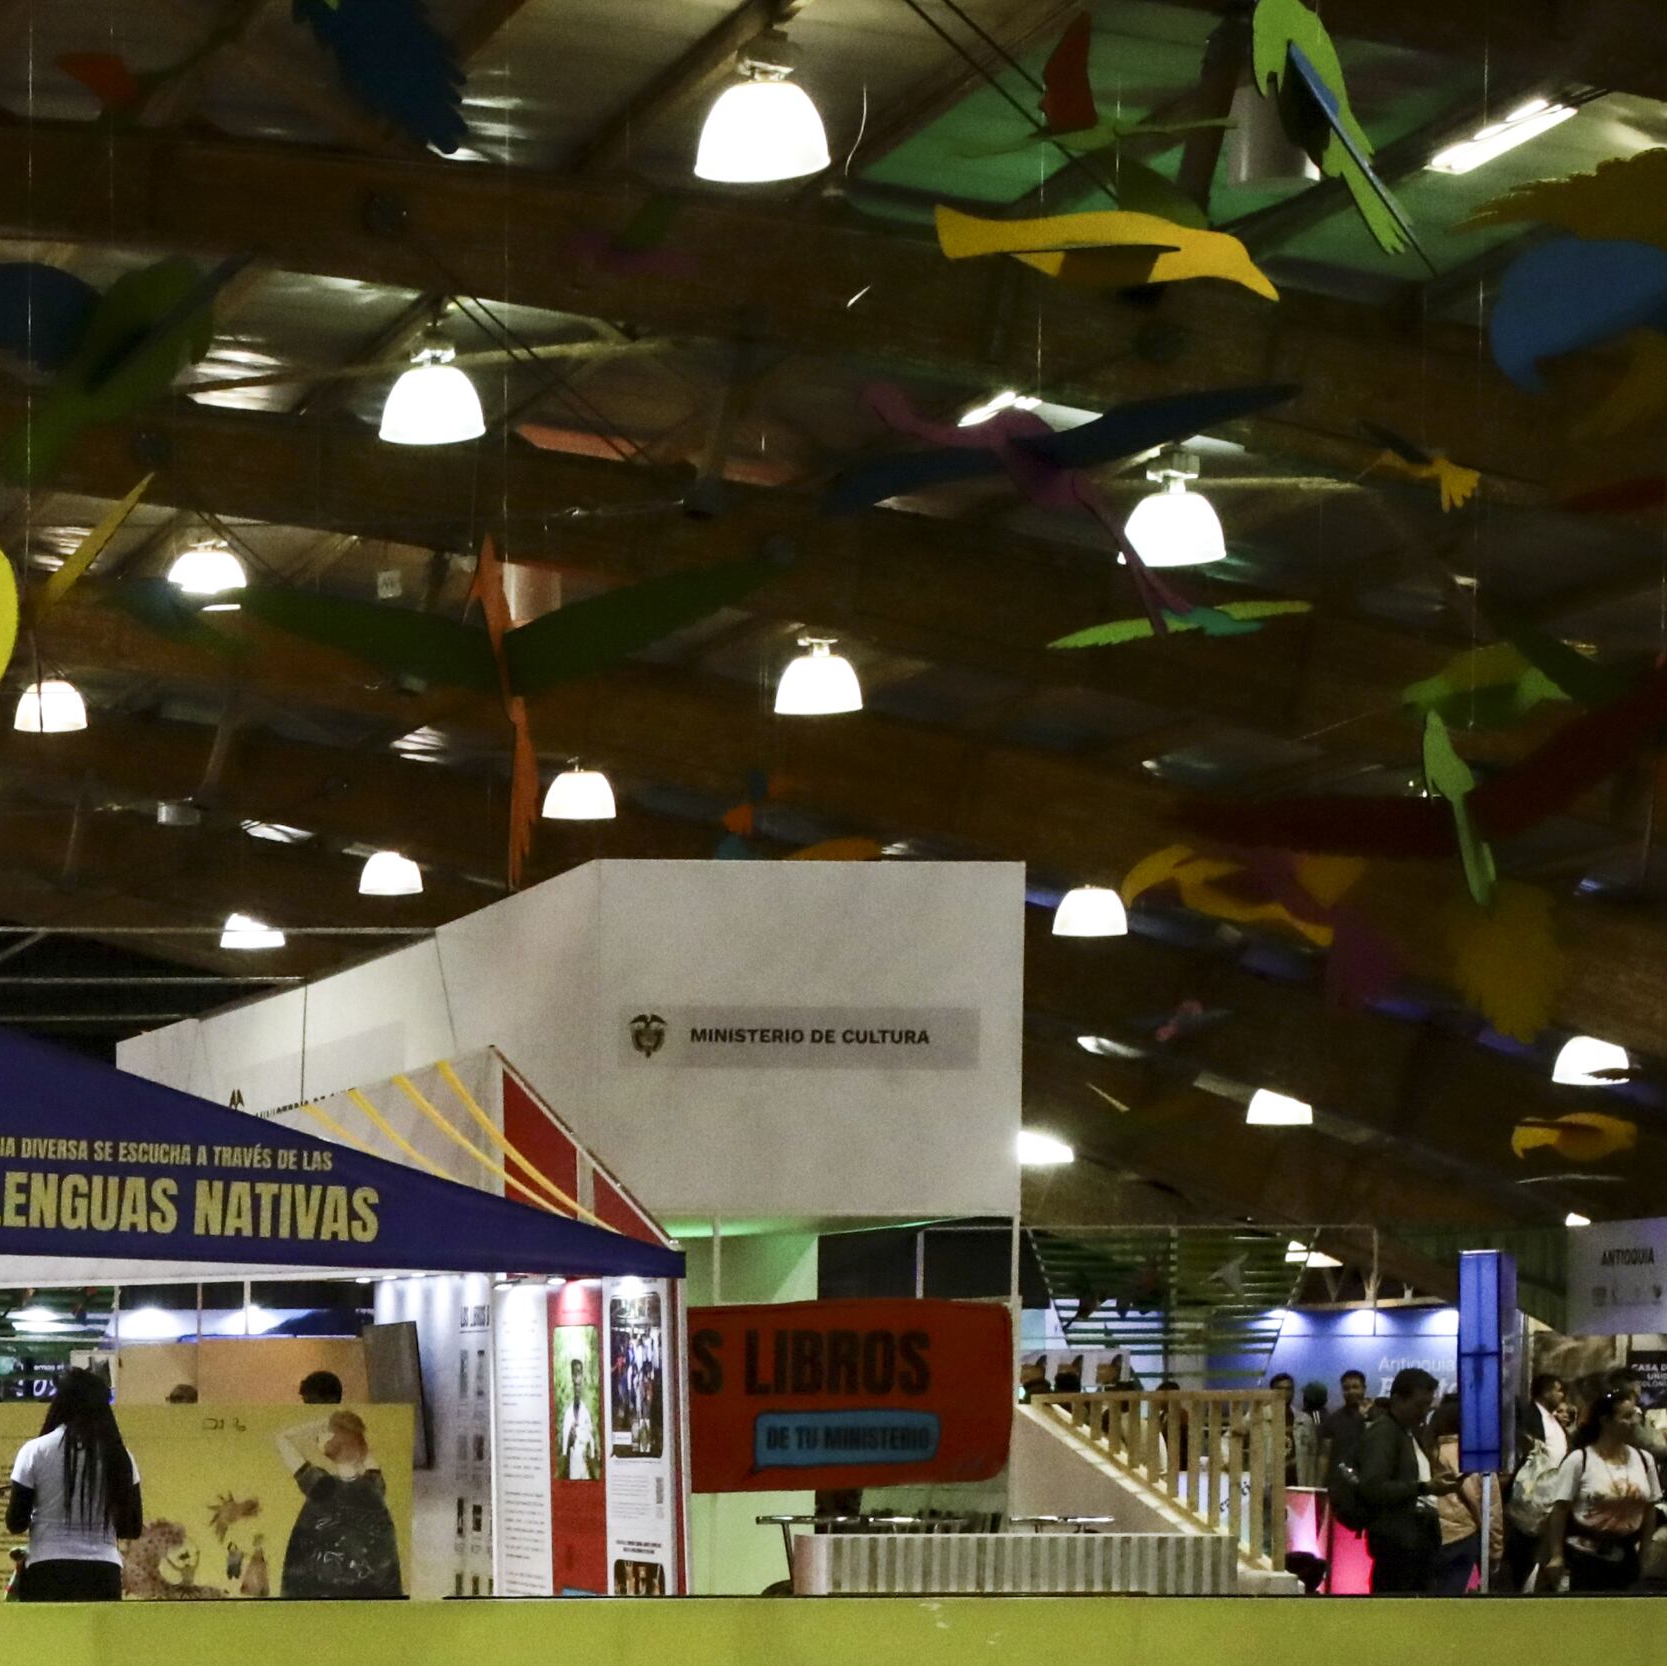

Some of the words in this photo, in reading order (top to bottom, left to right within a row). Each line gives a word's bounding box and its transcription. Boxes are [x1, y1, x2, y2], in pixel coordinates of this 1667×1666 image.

[690, 1027, 805, 1045] MINISTERIO
[810, 1029, 836, 1045] DE
[842, 1028, 930, 1046] CULTURA
[20, 1136, 88, 1161] DIVERSA
[94, 1140, 114, 1162] SE
[119, 1141, 192, 1166] ESCUCHA
[196, 1145, 208, 1166] A
[212, 1142, 273, 1170] TRAVÉS
[277, 1149, 299, 1171] DE
[303, 1150, 333, 1172] LAS
[193, 1179, 380, 1243] NATIVAS
[745, 1328, 931, 1397] LIBROS
[766, 1424, 791, 1452] DE
[795, 1424, 819, 1452] TU
[822, 1423, 931, 1452] MINISTERIO
